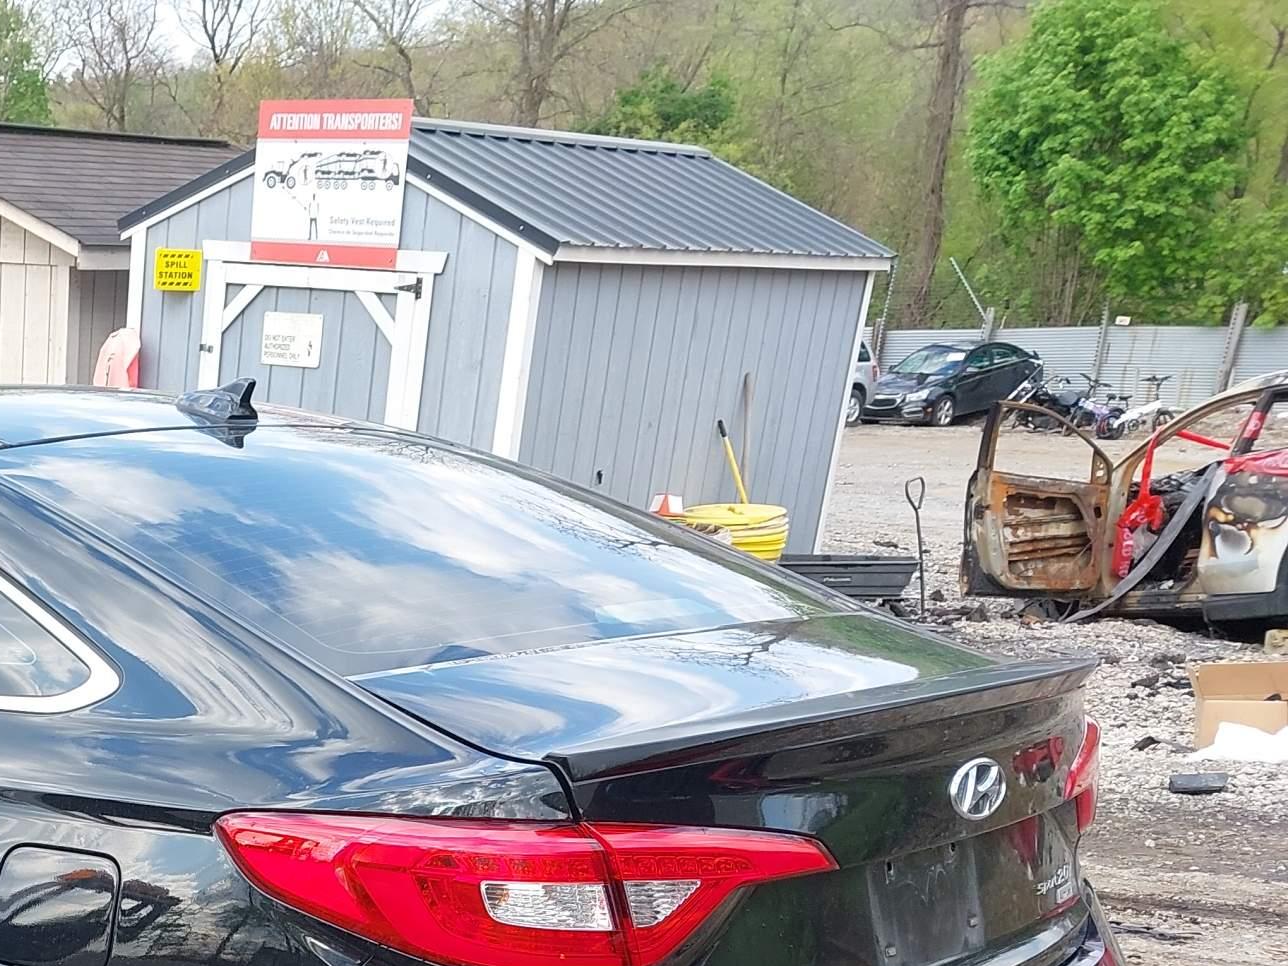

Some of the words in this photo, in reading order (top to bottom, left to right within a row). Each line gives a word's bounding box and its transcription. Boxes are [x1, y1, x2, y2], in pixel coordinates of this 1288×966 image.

[270, 111, 321, 131] ATTENTION
[322, 111, 403, 131] TRANSPORTERS!
[165, 261, 188, 269] SPILL
[158, 271, 193, 279] STATION
